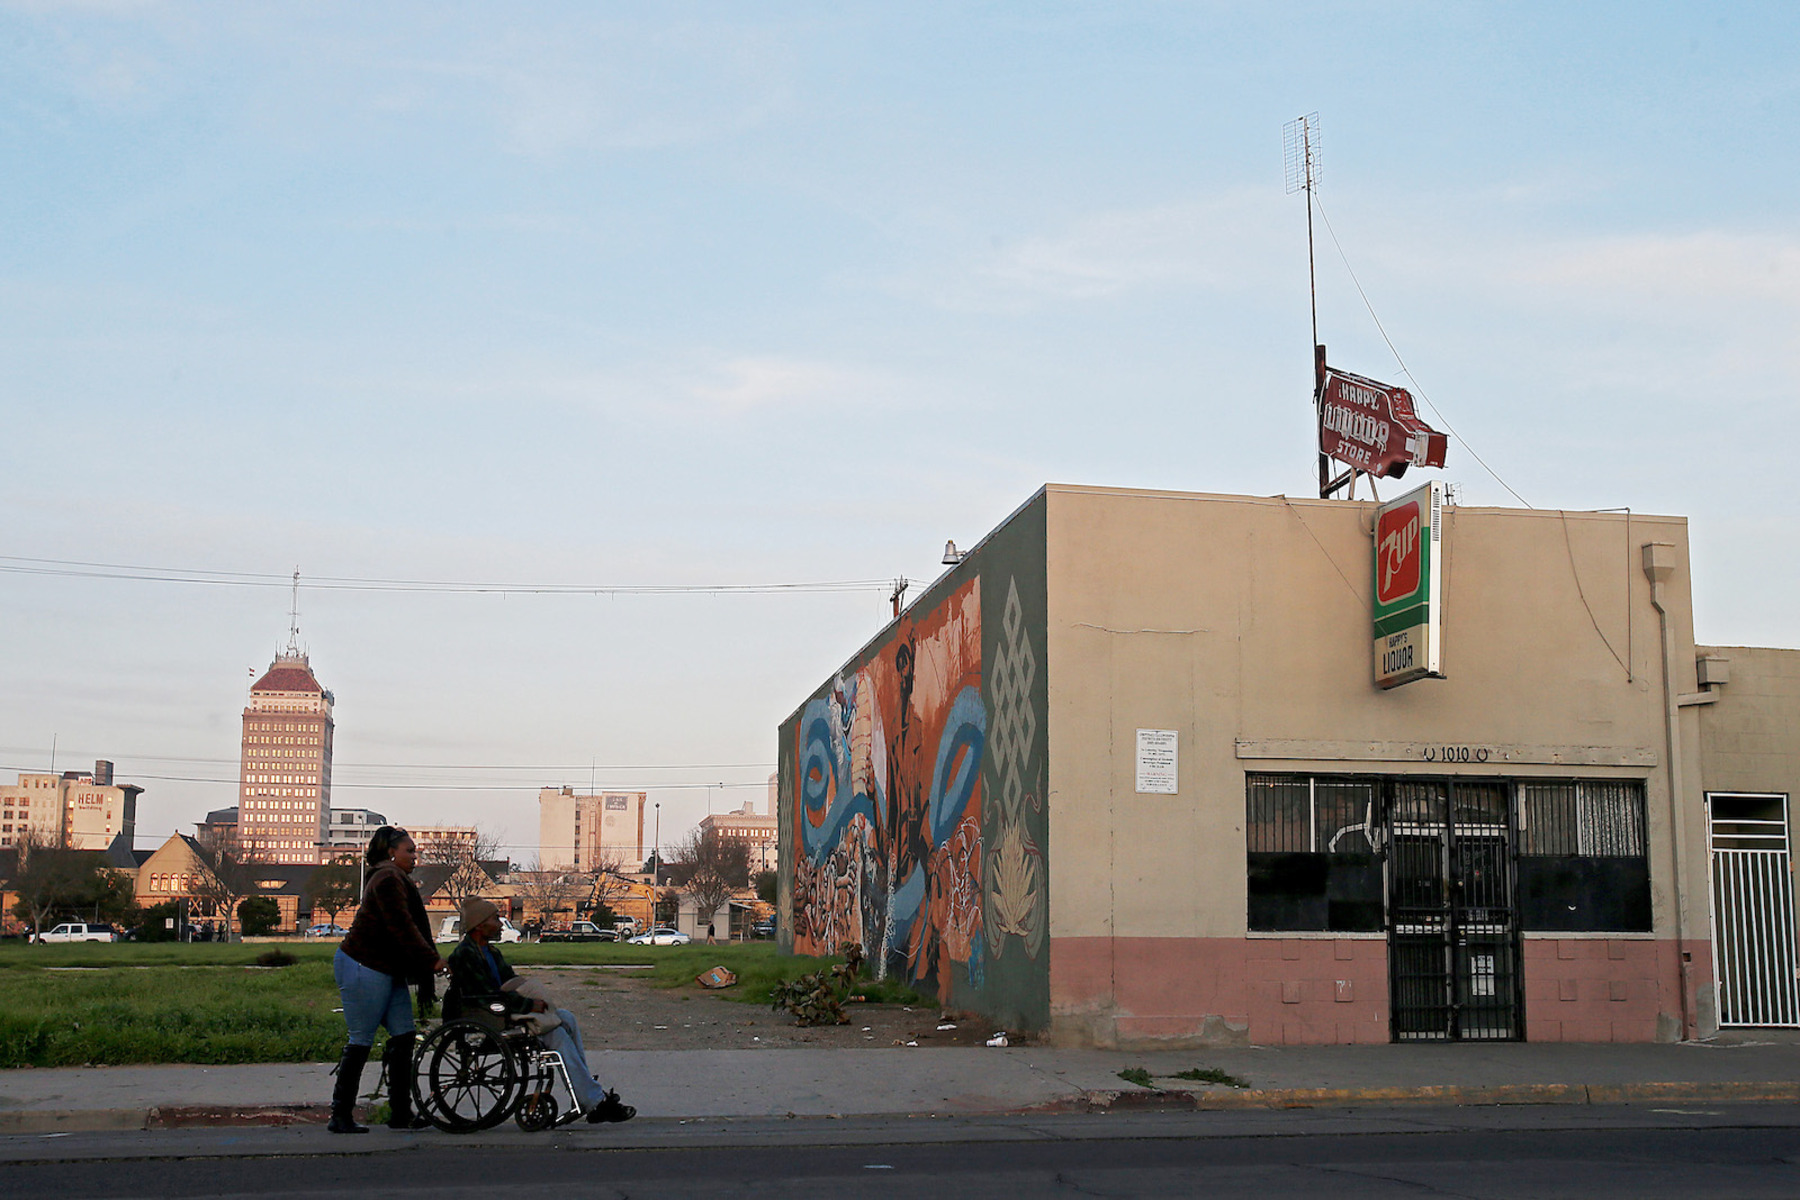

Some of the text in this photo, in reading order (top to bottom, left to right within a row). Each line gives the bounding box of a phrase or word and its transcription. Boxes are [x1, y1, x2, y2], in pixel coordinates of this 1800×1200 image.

[1339, 382, 1380, 410] HAPPY
[1324, 402, 1389, 456] LIQUOR
[1337, 440, 1371, 464] STORE
[1383, 645, 1413, 675] LIQUOR
[1441, 746, 1469, 762] 1010
[78, 793, 104, 805] HELM
